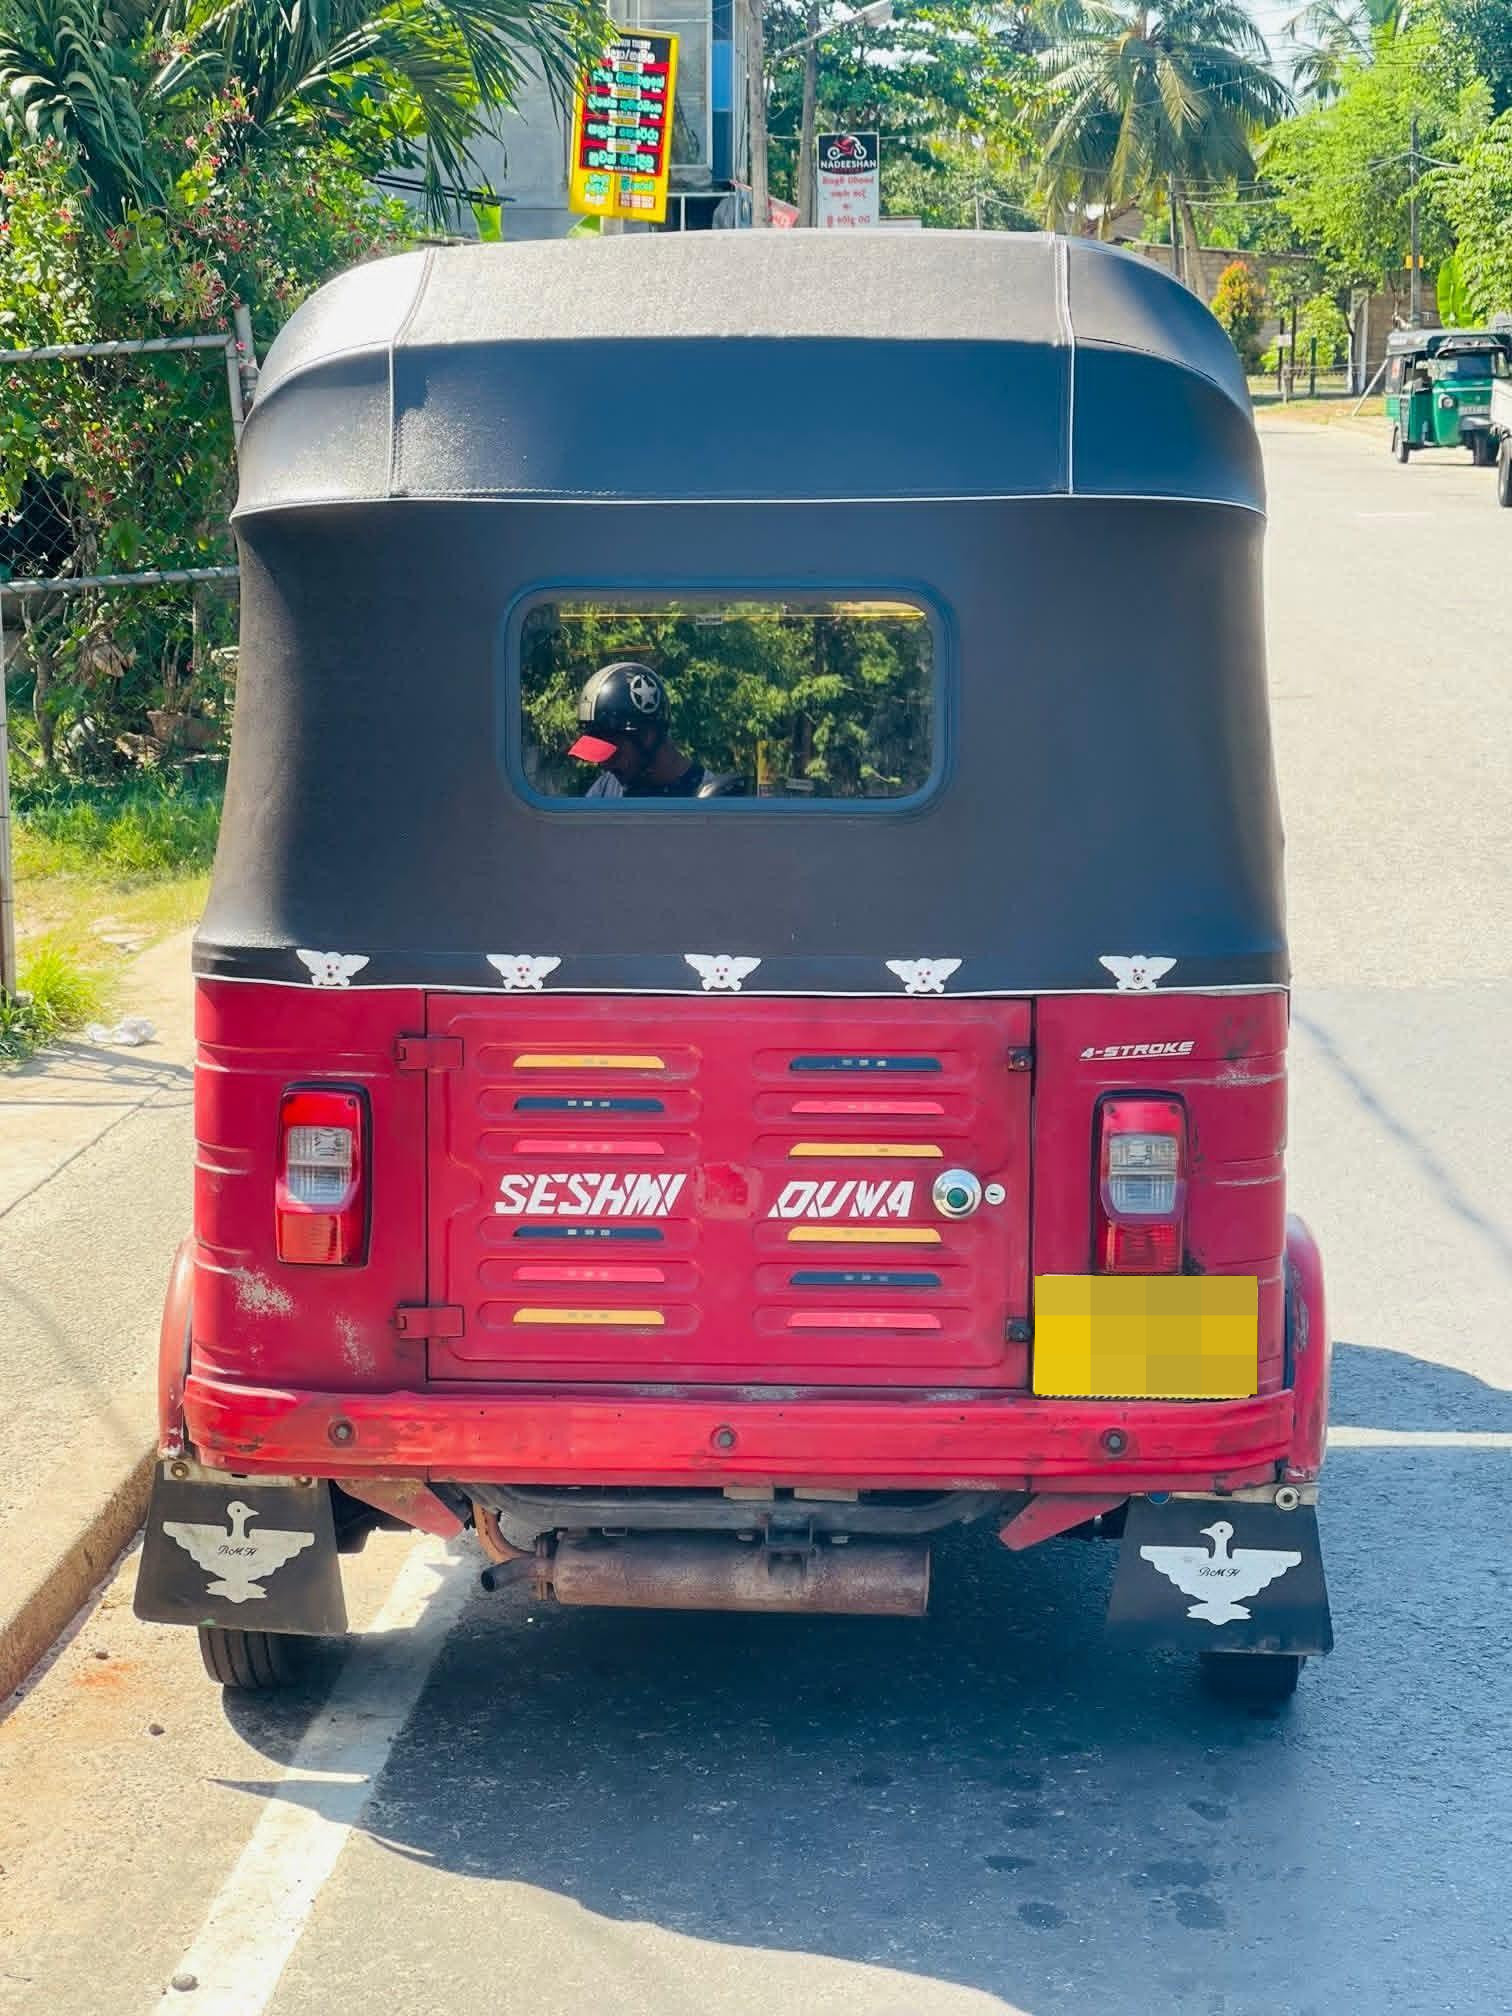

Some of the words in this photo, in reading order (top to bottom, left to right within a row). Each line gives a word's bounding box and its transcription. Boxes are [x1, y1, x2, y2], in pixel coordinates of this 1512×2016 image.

[820, 160, 877, 169] NADEESHAN
[1081, 1041, 1194, 1058] 4-STROKE
[494, 1173, 687, 1216] SESHMI
